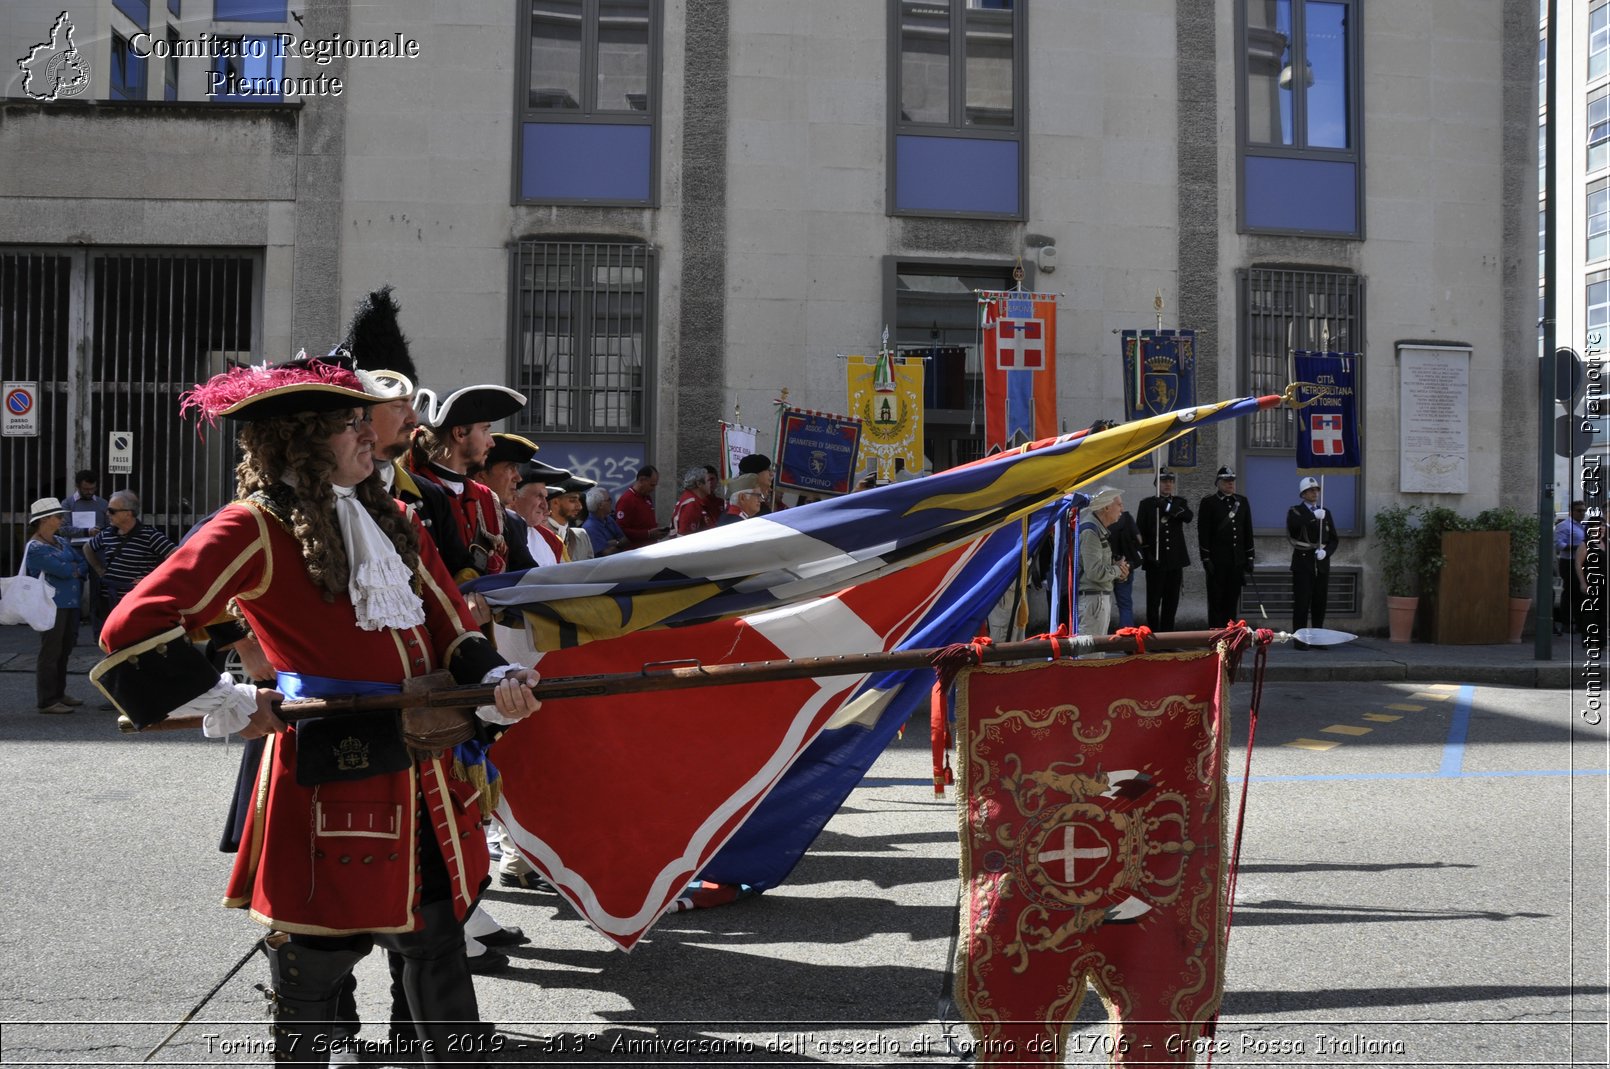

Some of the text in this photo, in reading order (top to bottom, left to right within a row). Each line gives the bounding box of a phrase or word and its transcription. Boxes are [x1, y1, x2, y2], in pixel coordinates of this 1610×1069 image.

[1301, 386, 1353, 396] METROPOLITANA
[788, 436, 818, 448] GRANATIERI
[825, 443, 850, 453] SARDEGNA
[800, 476, 832, 488] TORINO
